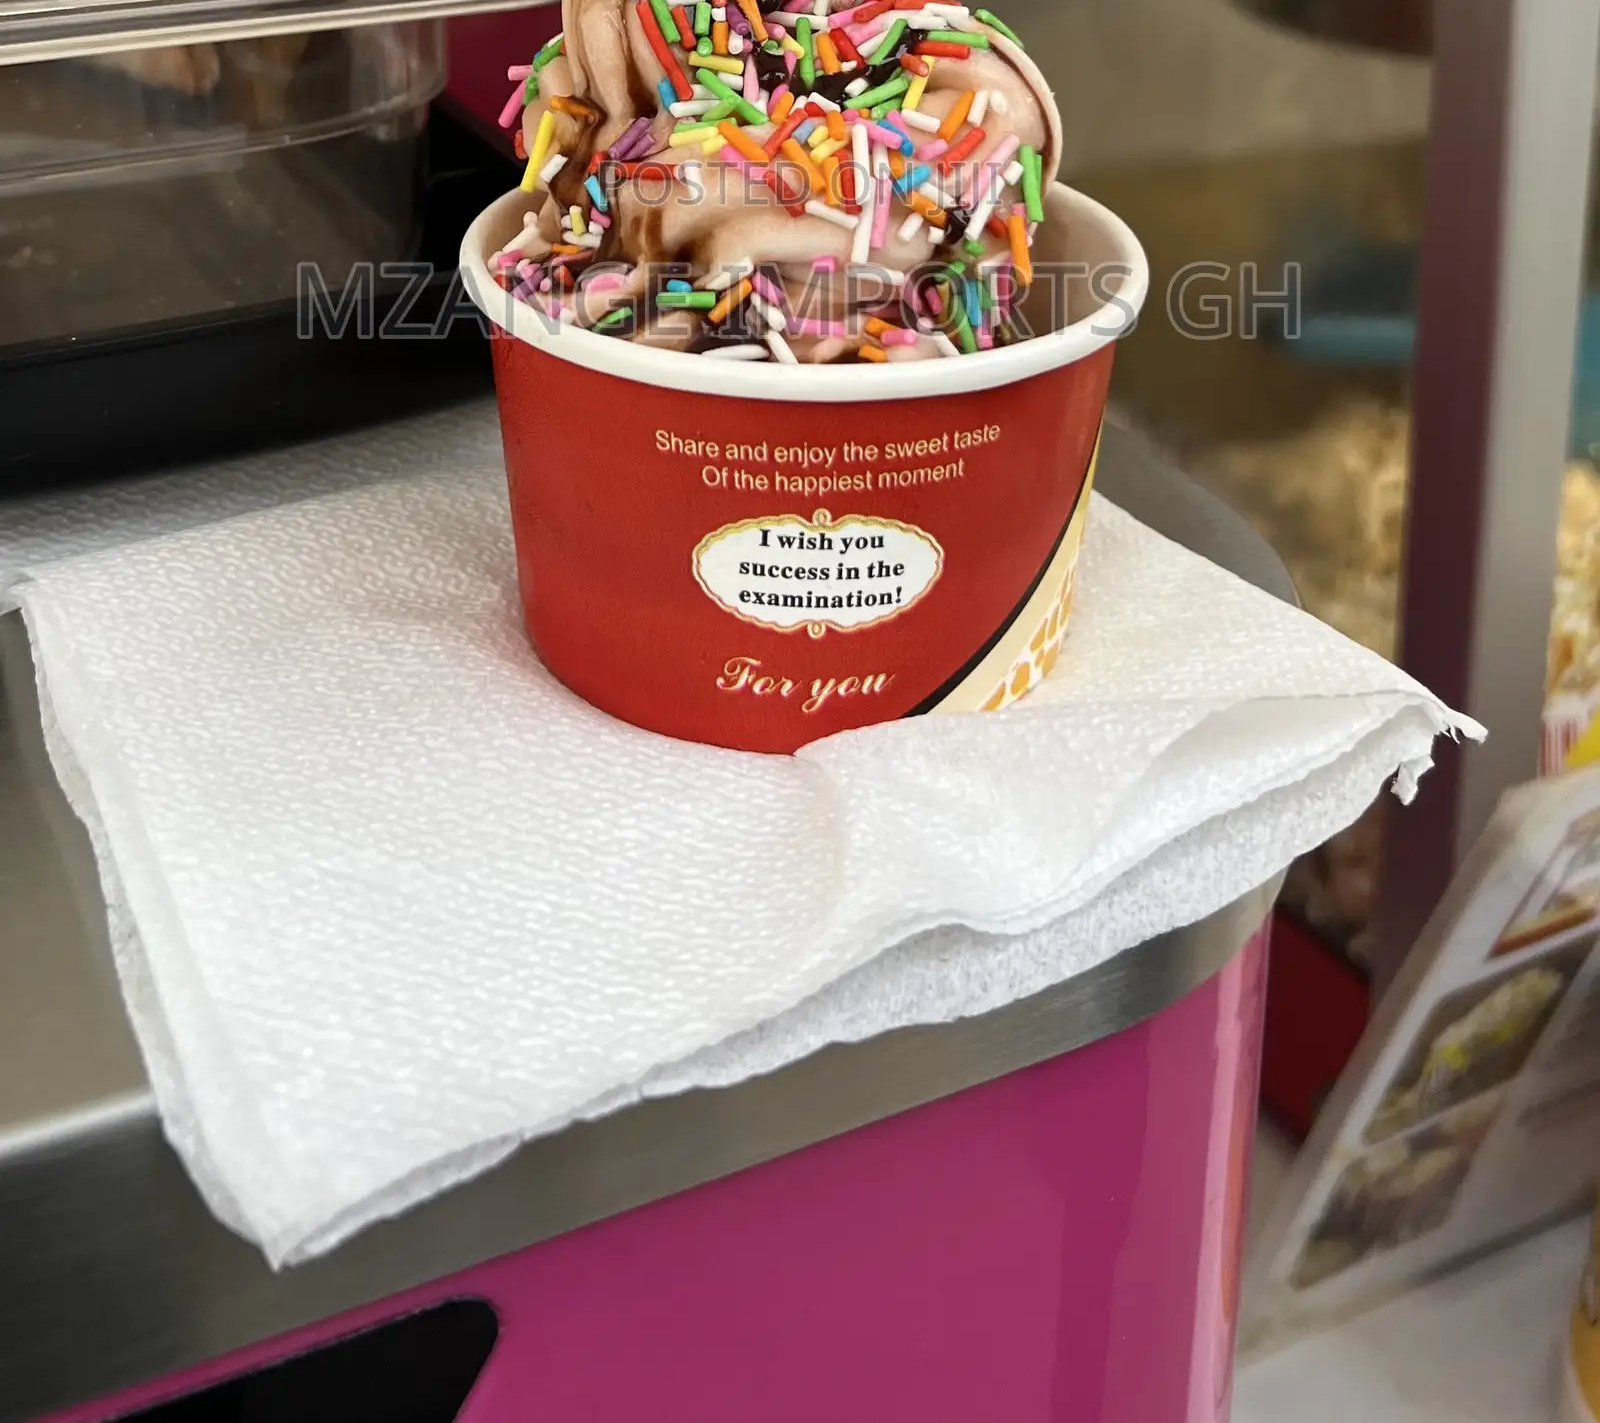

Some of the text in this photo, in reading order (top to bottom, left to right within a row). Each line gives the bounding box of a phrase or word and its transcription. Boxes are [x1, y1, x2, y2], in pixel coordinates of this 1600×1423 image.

[654, 423, 1001, 468] Share and enjoy the sweet taste
[701, 458, 965, 497] Of the happiest moment
[758, 529, 885, 554] I wish you
[738, 560, 905, 581] success in the
[738, 586, 903, 609] examination!
[715, 656, 897, 714] For you
